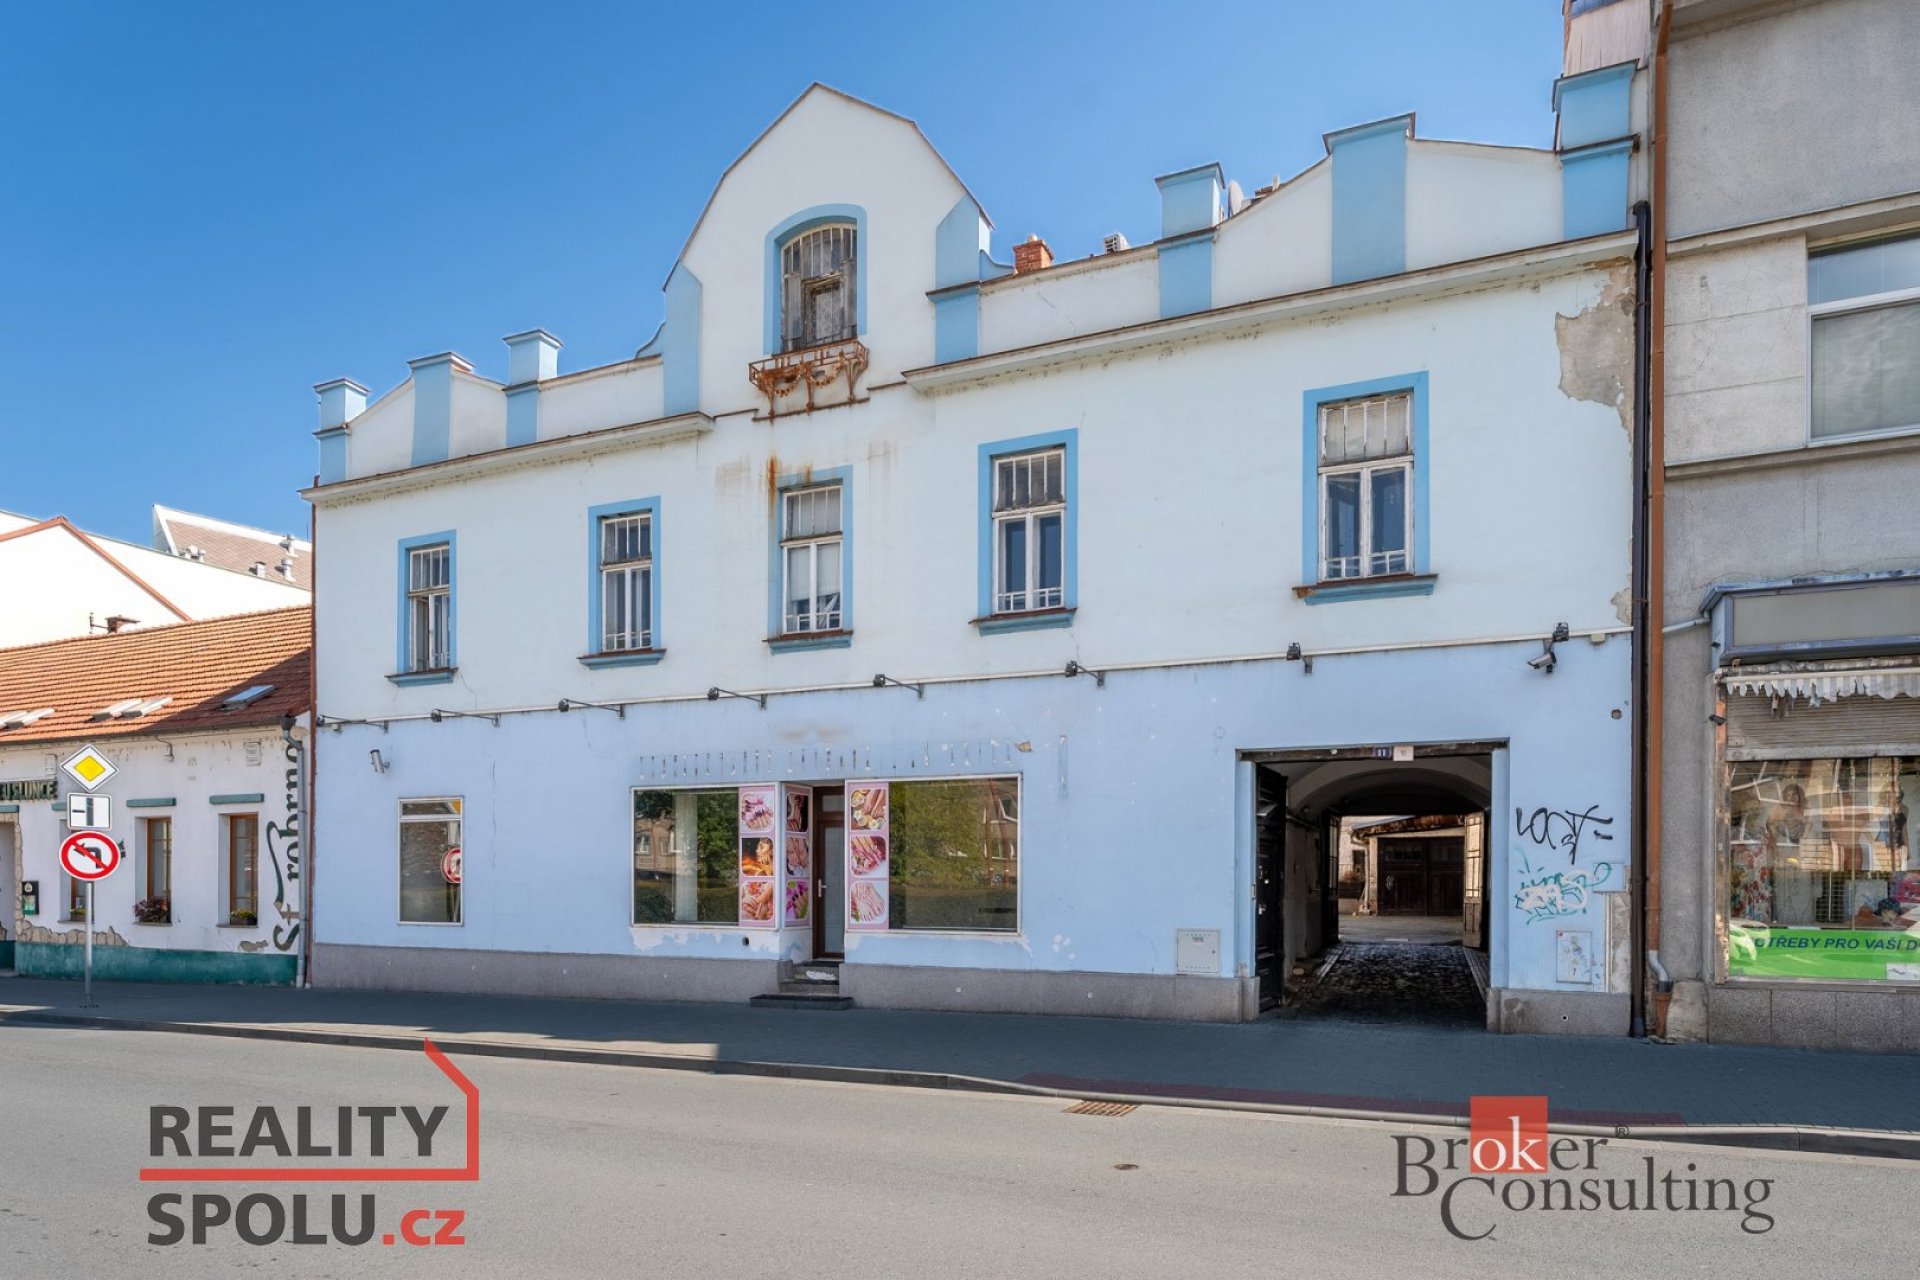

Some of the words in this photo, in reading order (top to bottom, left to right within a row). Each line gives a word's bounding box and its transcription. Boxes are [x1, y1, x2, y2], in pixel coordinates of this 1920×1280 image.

[1823, 938, 1859, 949] PRO
[1864, 937, 1901, 951] VAŠI
[1905, 939, 1920, 951] D
